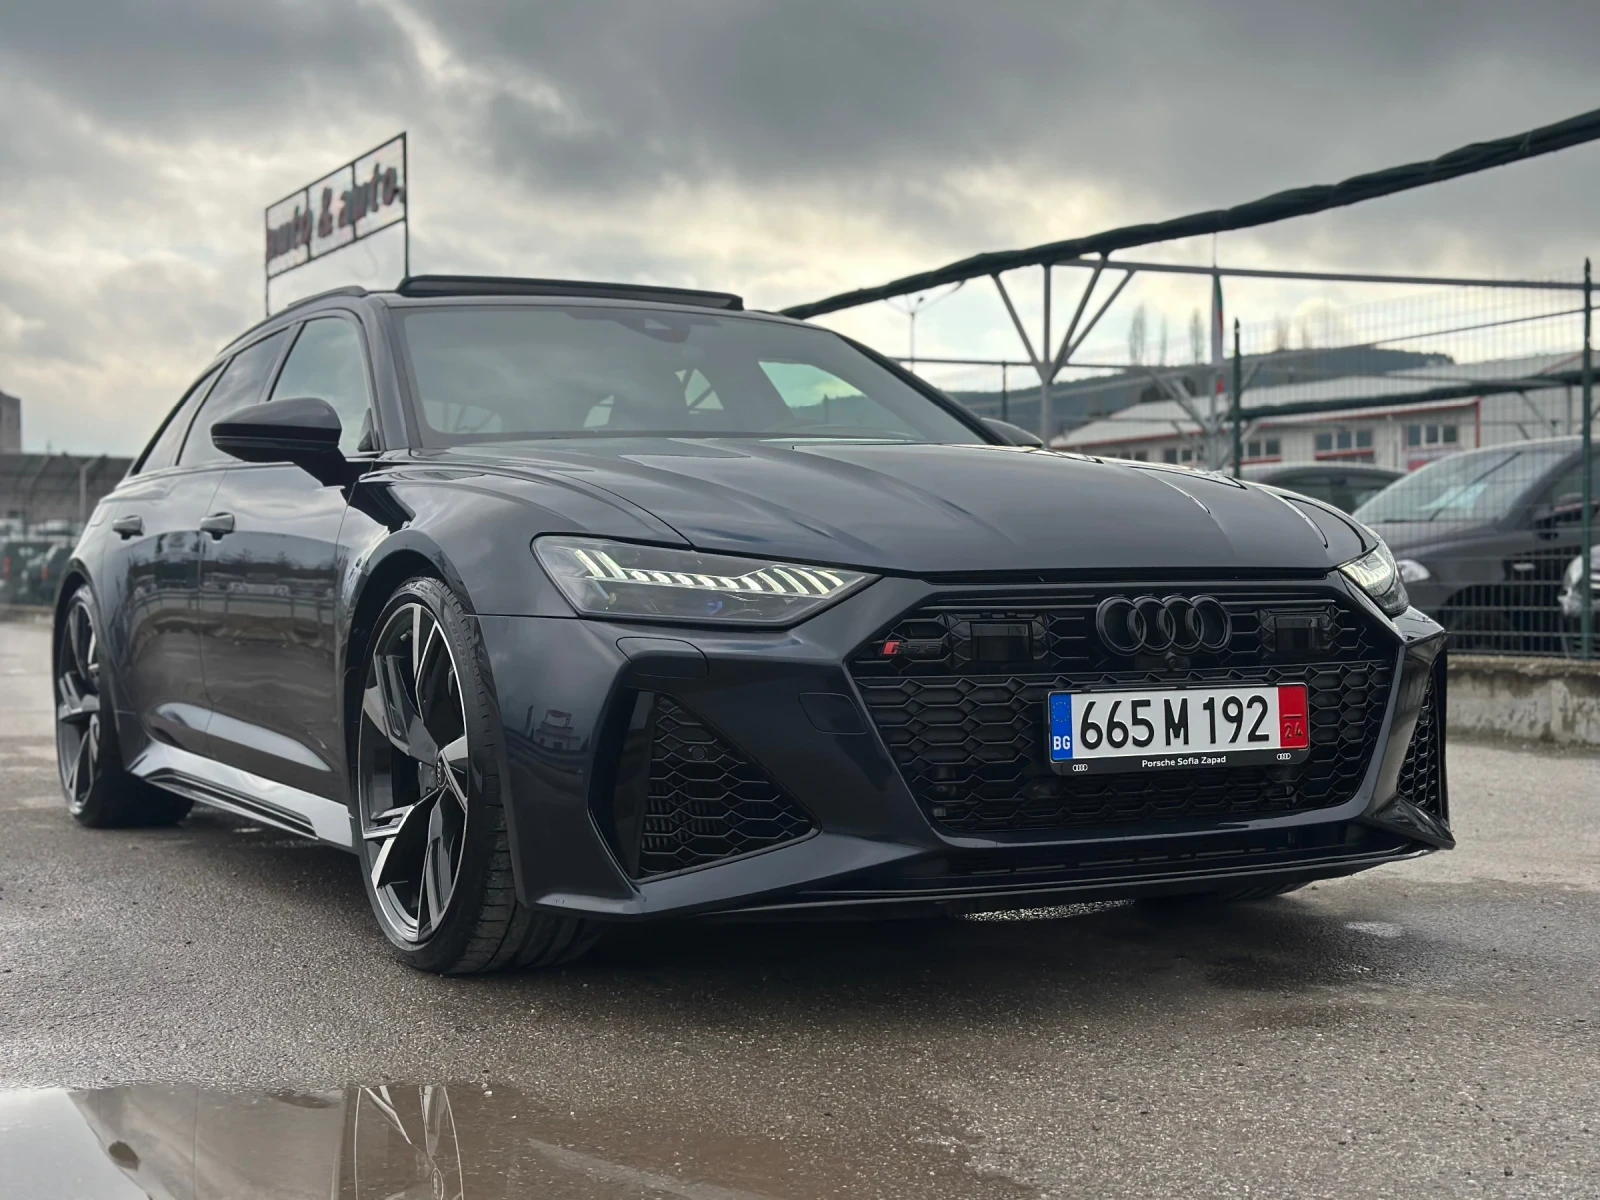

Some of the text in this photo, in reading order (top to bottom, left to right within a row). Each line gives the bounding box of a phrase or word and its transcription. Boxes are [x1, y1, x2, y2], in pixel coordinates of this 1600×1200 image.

[1080, 695, 1269, 750] 665 M 192
[1053, 735, 1071, 750] BG
[1142, 756, 1226, 768] Porsche Sofia Zapad
